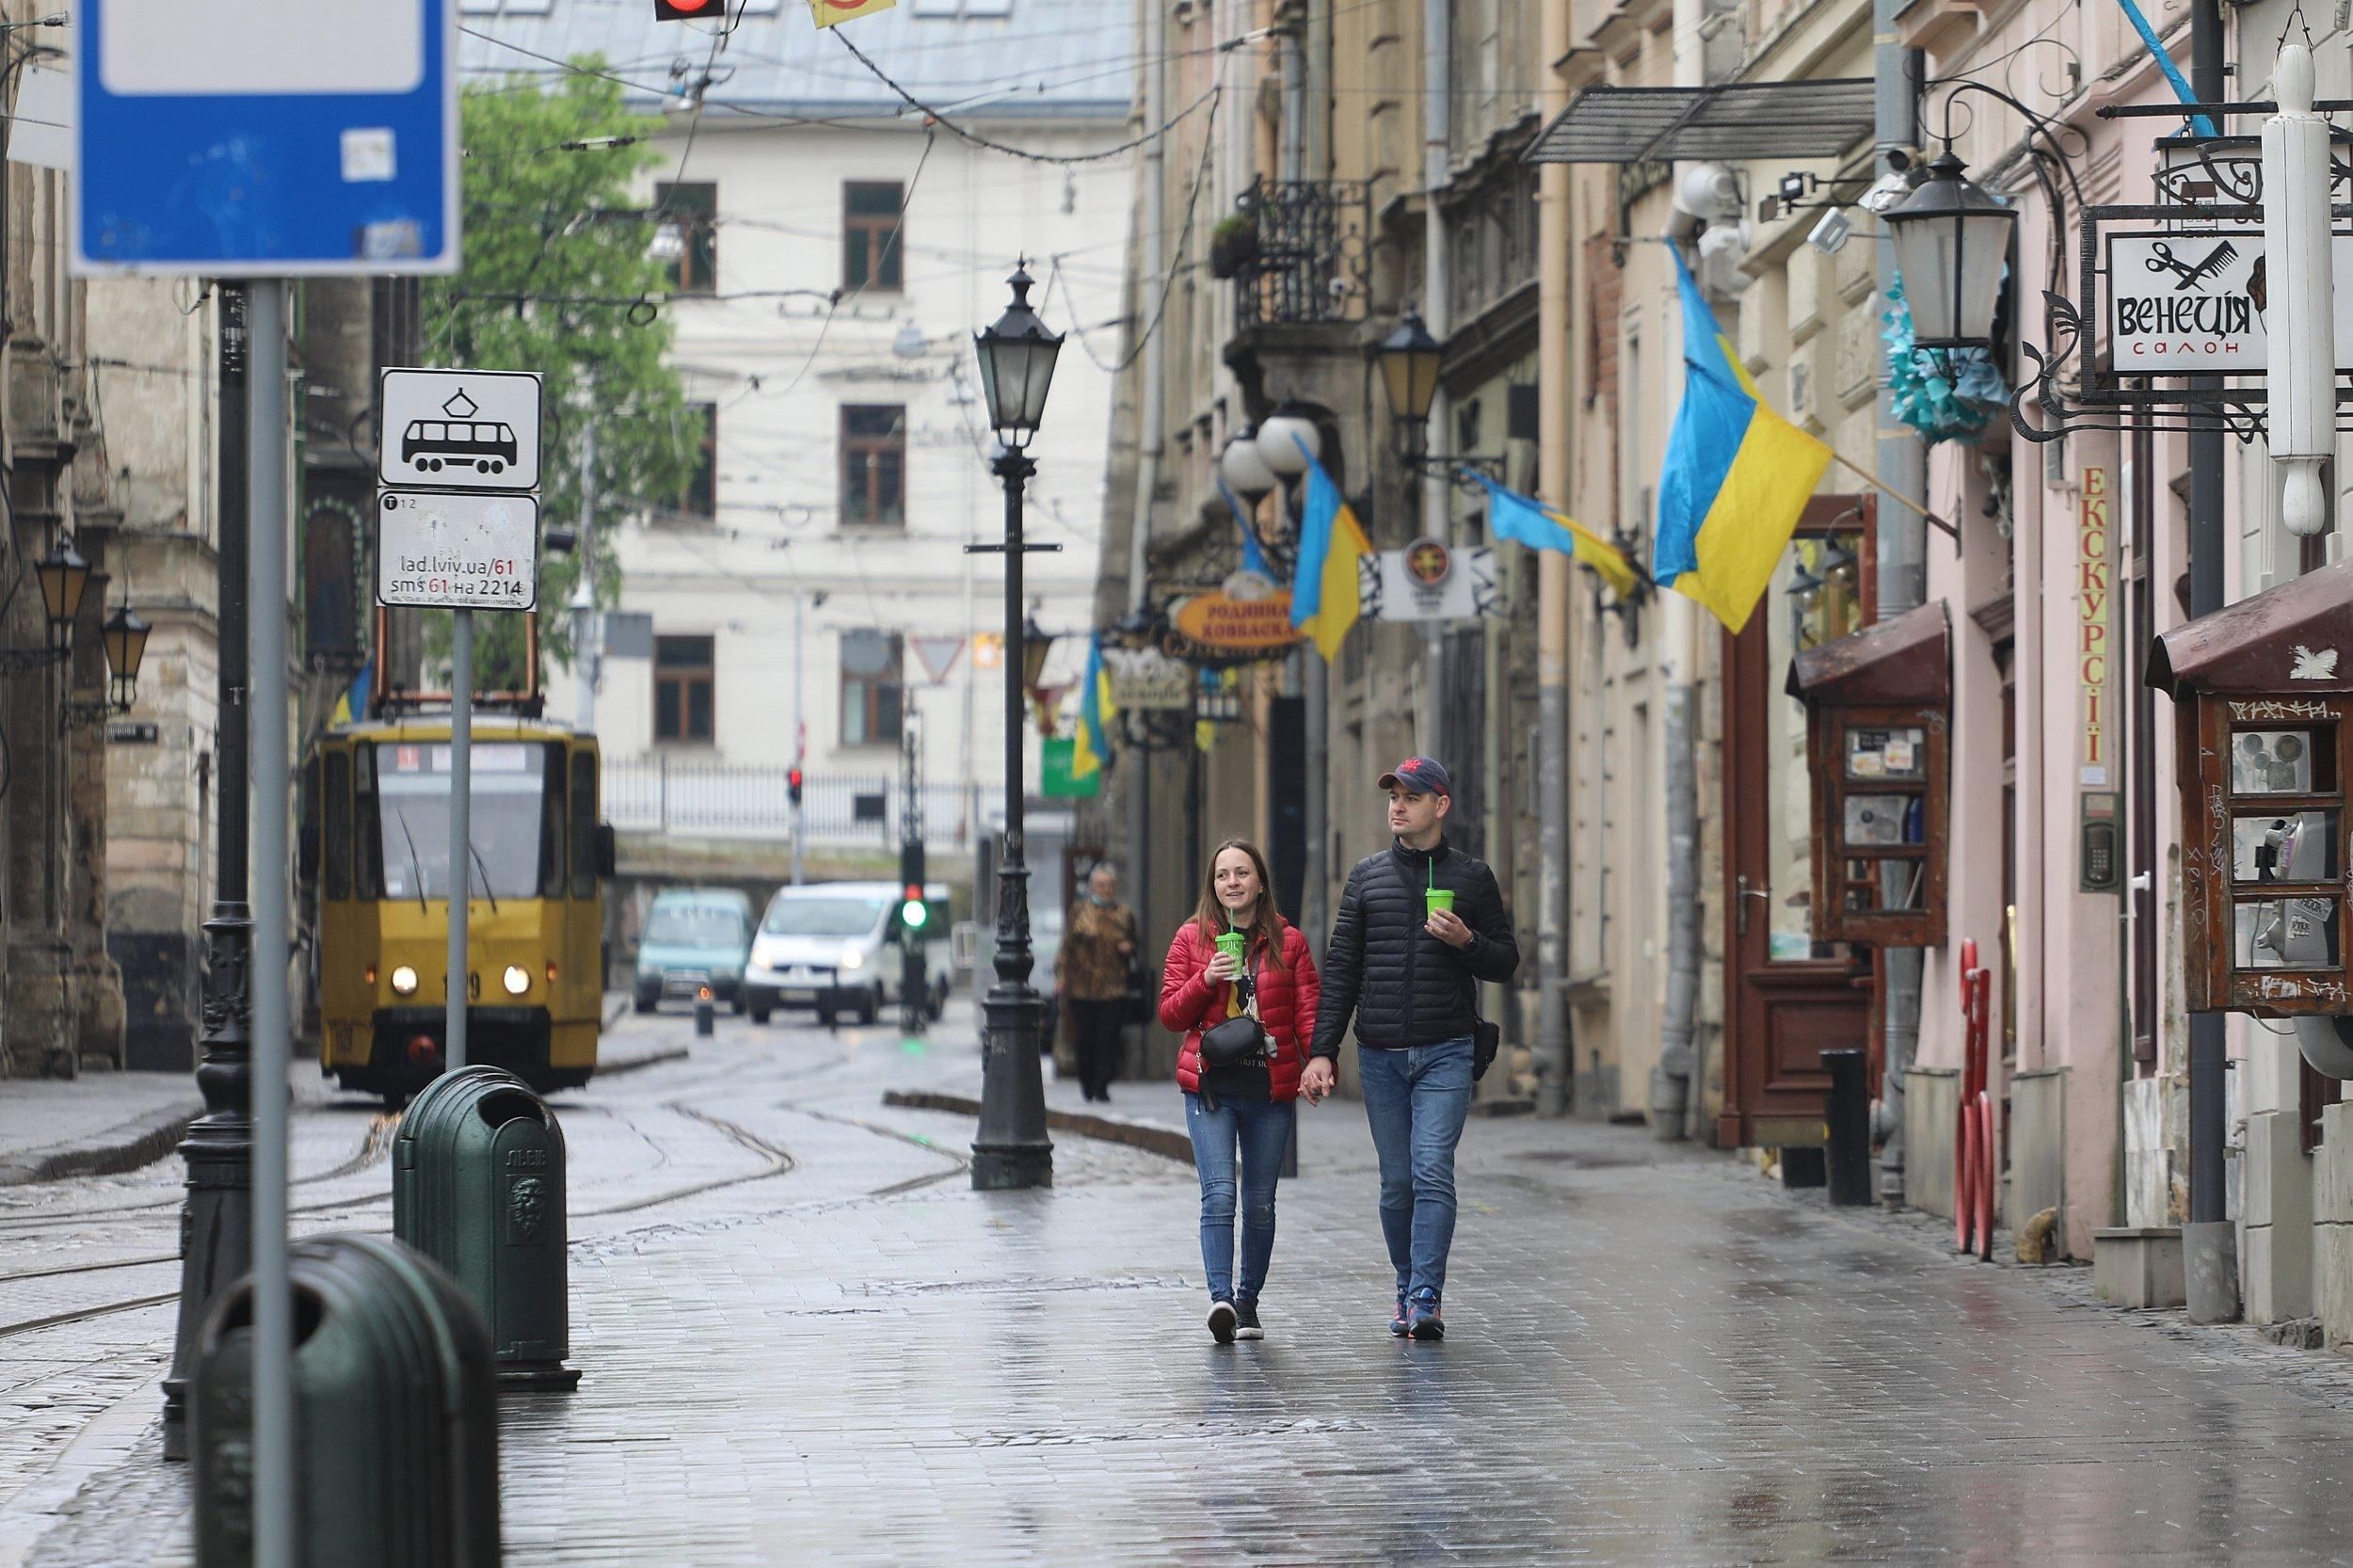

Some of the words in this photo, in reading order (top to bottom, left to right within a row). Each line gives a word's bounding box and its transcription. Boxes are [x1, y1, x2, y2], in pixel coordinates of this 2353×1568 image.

[390, 580, 424, 593] sms
[428, 578, 449, 594] 61
[454, 582, 474, 595] на
[479, 579, 522, 596] 2214
[2080, 466, 2106, 763] ЕКСКУРСІЇ
